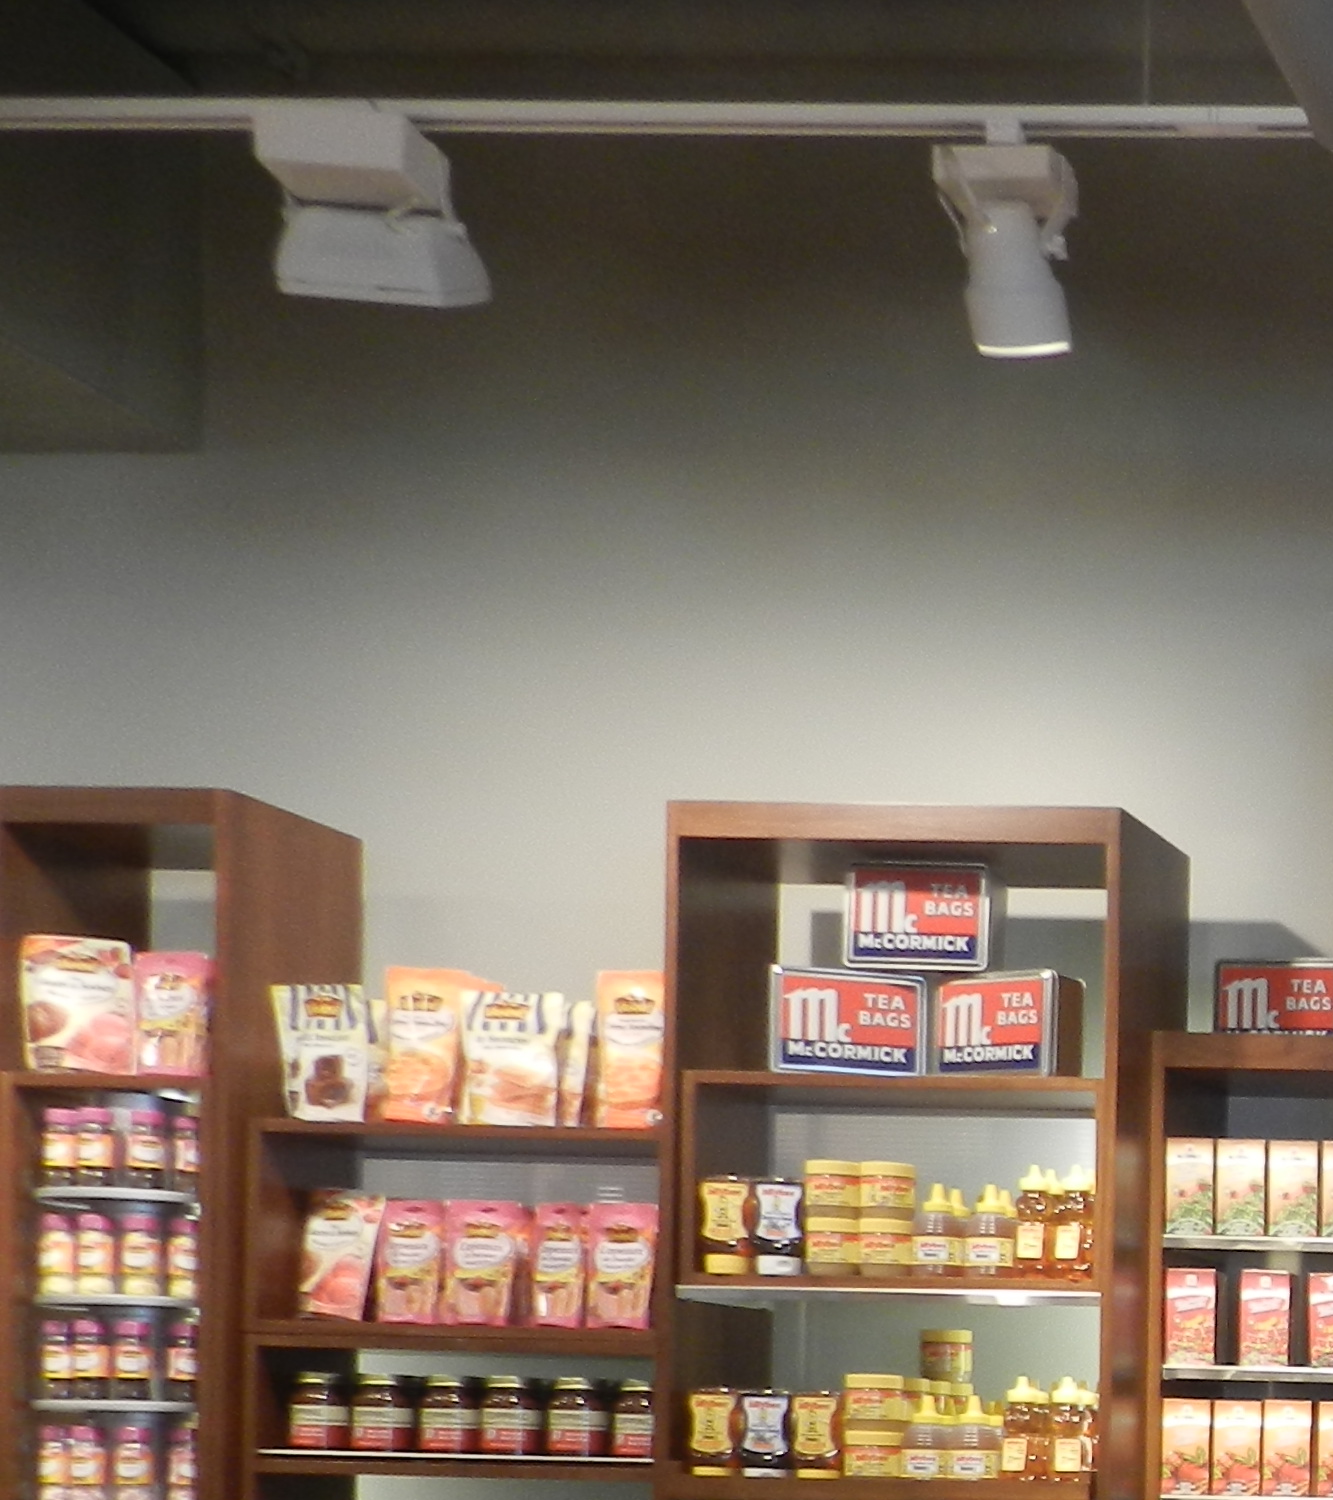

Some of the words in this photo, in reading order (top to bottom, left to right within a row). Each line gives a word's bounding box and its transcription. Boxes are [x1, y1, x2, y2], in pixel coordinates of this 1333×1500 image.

[931, 883, 967, 899] TEA
[924, 900, 974, 917] BAGS
[1290, 979, 1326, 994] TEA
[863, 993, 905, 1011] TEA
[1001, 992, 1033, 1007] TEA
[1285, 996, 1332, 1011] BAGS
[858, 1010, 911, 1029] BAGS
[997, 1010, 1038, 1025] BAGS
